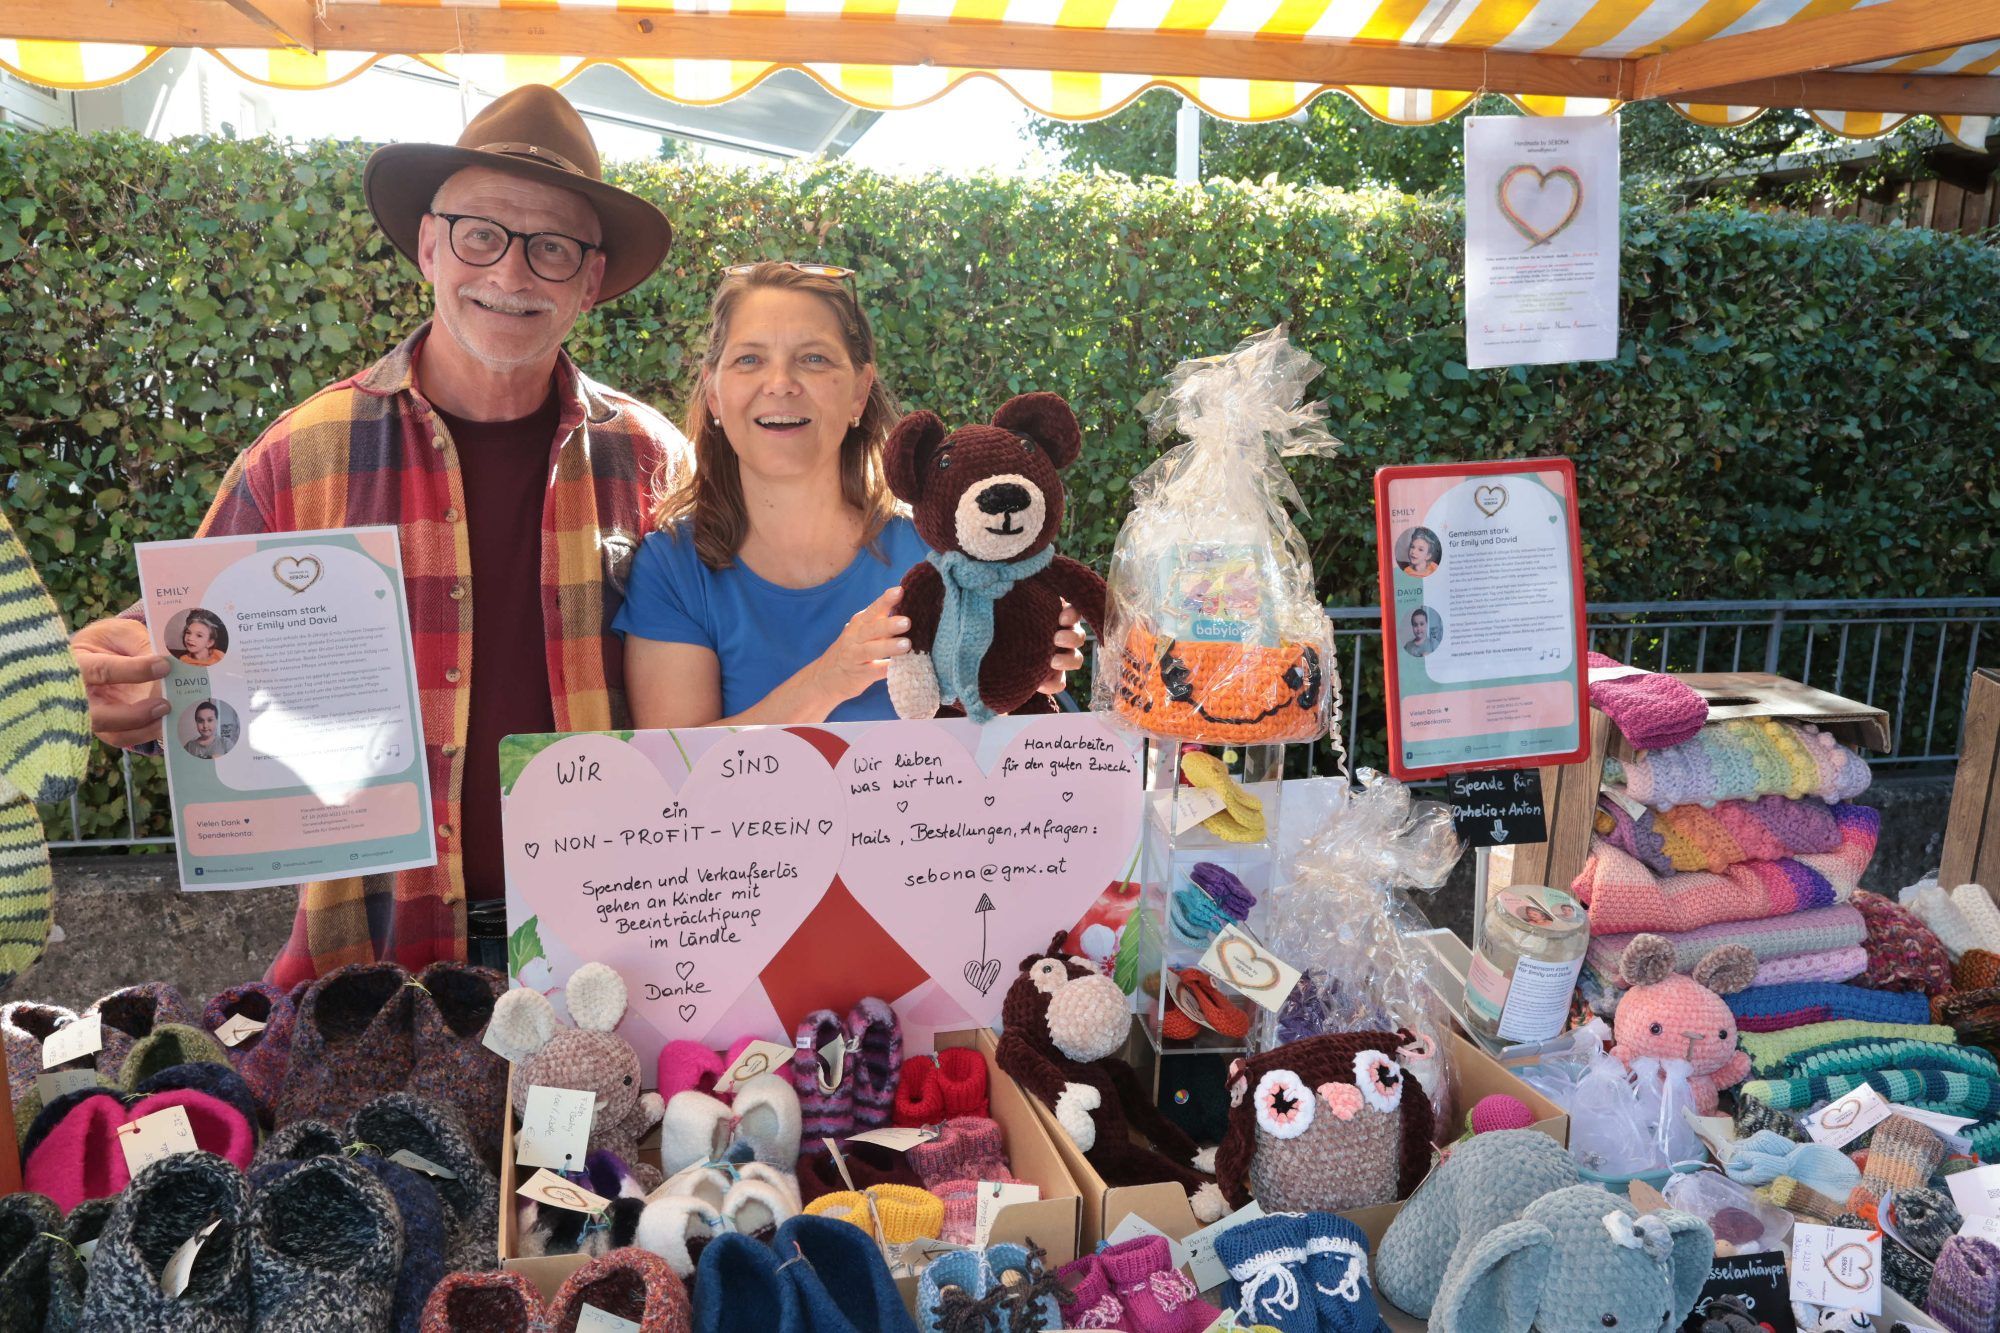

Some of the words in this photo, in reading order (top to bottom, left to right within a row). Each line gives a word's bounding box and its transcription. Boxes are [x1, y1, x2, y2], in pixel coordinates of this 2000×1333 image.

[1392, 508, 1415, 516] EMILY
[1449, 530, 1488, 538] Gemeinsam
[1490, 527, 1509, 535] stark
[1449, 540, 1459, 548] für
[1461, 538, 1479, 548] Emily
[1481, 537, 1495, 545] und
[1496, 536, 1518, 544] David
[156, 586, 189, 597] EMILY
[1397, 588, 1423, 597] DAVID
[237, 607, 298, 621] Gemeinsam
[300, 605, 327, 616] stark
[238, 622, 254, 632] für
[257, 618, 285, 631] Emily
[287, 617, 307, 628] und
[309, 615, 338, 626] David
[175, 678, 208, 687] DAVID
[1024, 735, 1114, 752] Handarbeiten
[853, 757, 883, 774] Wir
[894, 751, 943, 768] lieben
[1002, 759, 1020, 778] für
[1024, 758, 1044, 771] den
[1050, 757, 1083, 779] guten
[1088, 756, 1132, 773] Zweck.
[851, 780, 881, 795] was
[893, 776, 917, 790] wir
[923, 773, 963, 788] tun.
[1454, 775, 1506, 797] Spende
[1513, 772, 1534, 792] für
[662, 801, 689, 819] ein
[1453, 804, 1498, 823] Ophelia
[1509, 800, 1541, 816] Anton
[197, 819, 219, 828] Vielen
[220, 817, 241, 827] Dank
[911, 822, 1017, 845] Bestellungen,
[1020, 819, 1098, 843] Anfragen:
[197, 830, 254, 841] Spendenkonto:
[582, 875, 652, 899] Spenden
[658, 868, 689, 888] und
[697, 861, 798, 887] Verkaufserlös
[904, 857, 1067, 887] sebona@gmx.at
[597, 900, 641, 923] gehen
[647, 897, 667, 909] an
[673, 889, 722, 907] Kinder
[731, 886, 761, 902] mit
[616, 907, 762, 934] Beeinträchtigung
[649, 936, 669, 949] im
[679, 927, 741, 948] Ländle
[645, 980, 712, 1001] Danke
[1707, 1260, 1786, 1288] sselanhänger
